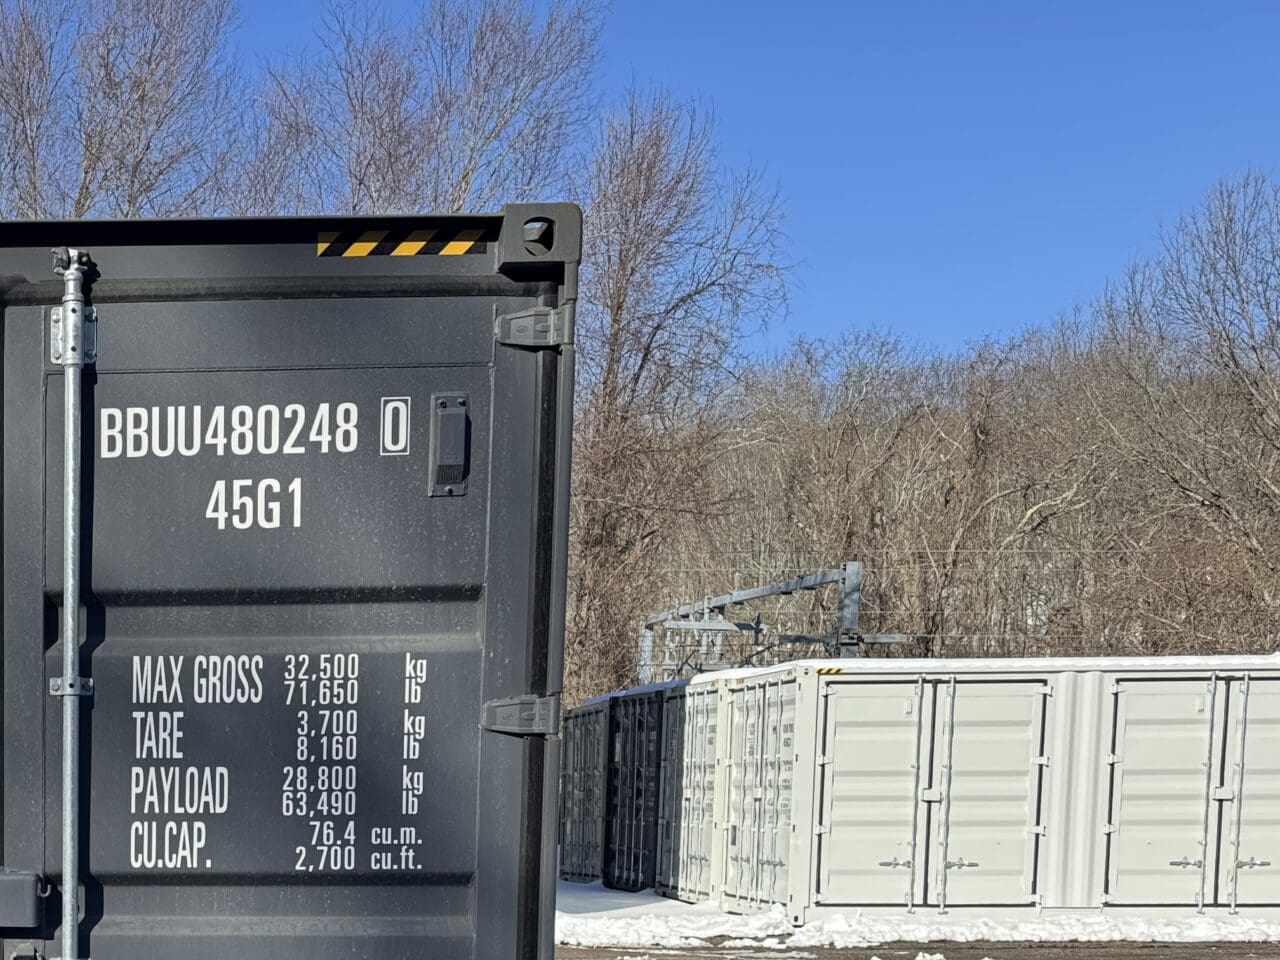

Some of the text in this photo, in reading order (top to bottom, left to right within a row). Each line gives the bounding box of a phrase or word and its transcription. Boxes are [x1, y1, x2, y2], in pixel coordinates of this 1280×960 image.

[100, 401, 408, 458] BBUU480248 0
[205, 477, 302, 530] 45G1
[132, 655, 264, 704] MAX GROSS
[284, 652, 427, 683] 32,500 kg
[283, 678, 422, 706] 71,650 lb
[132, 711, 184, 759] TARE
[297, 709, 426, 739] 3,700 kg
[296, 735, 420, 763] 8,160 lb
[130, 766, 229, 814] PAYLOAD
[282, 765, 424, 795] 28,800 kg
[282, 791, 419, 818] 63,490 lb
[130, 821, 212, 869] CU.CAP.
[309, 821, 423, 846] 76.4 cu.m.
[295, 846, 423, 872] 2,700 cu.ft.
